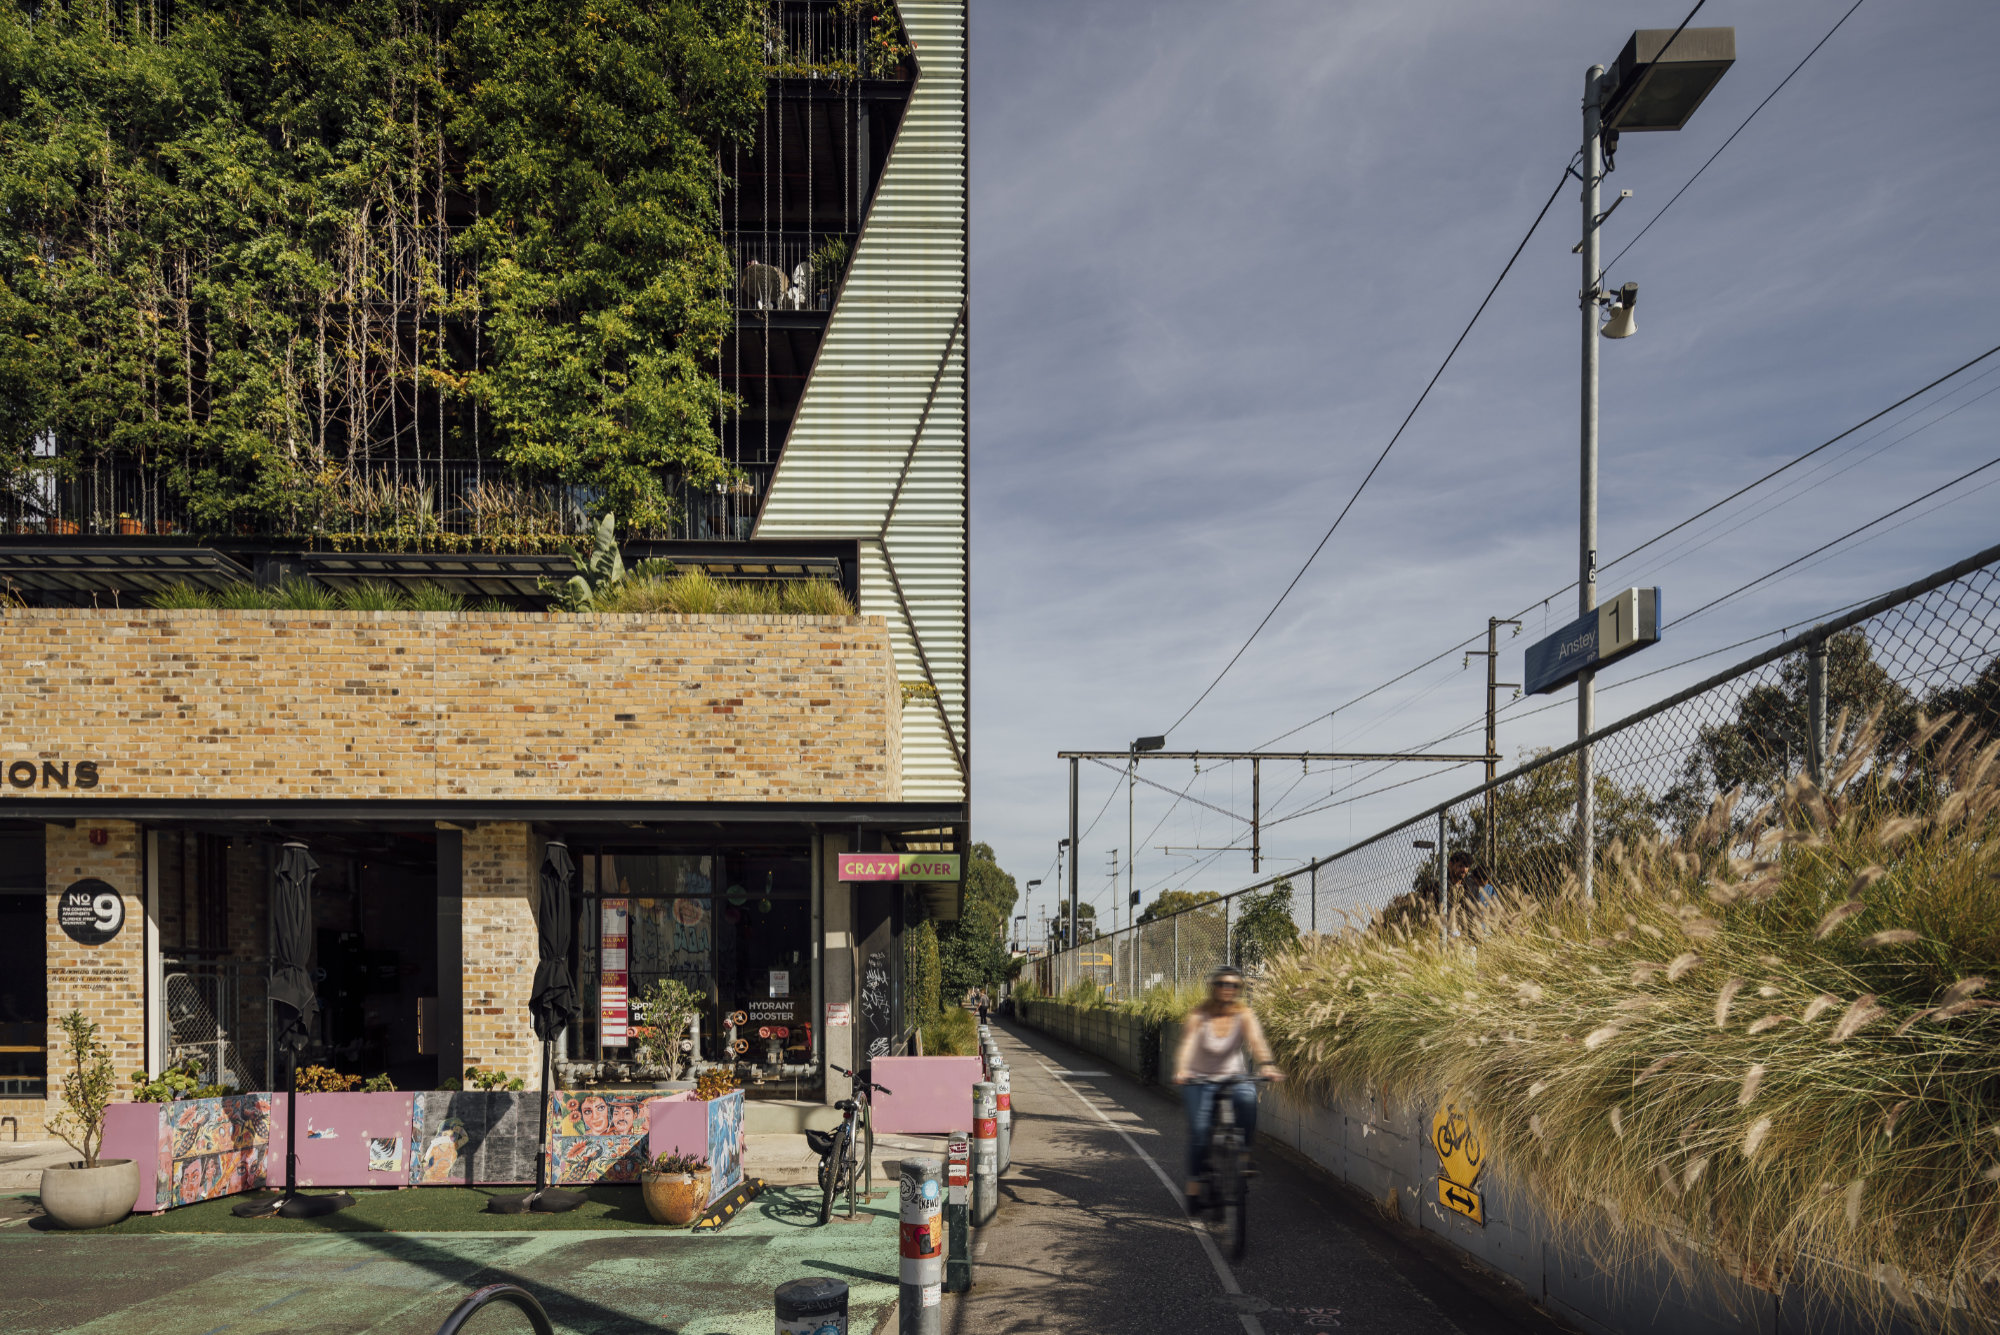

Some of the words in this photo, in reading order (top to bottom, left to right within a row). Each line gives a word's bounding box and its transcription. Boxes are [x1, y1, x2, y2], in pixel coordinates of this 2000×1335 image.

[1608, 600, 1620, 643] 1
[1559, 631, 1596, 660] Anstey
[0, 761, 99, 789] ONS
[845, 862, 898, 875] CRAZY
[901, 863, 951, 875] LOVER
[93, 893, 121, 931] 9
[749, 1002, 795, 1010] HYDRANT
[750, 1012, 794, 1020] BOOSTER
